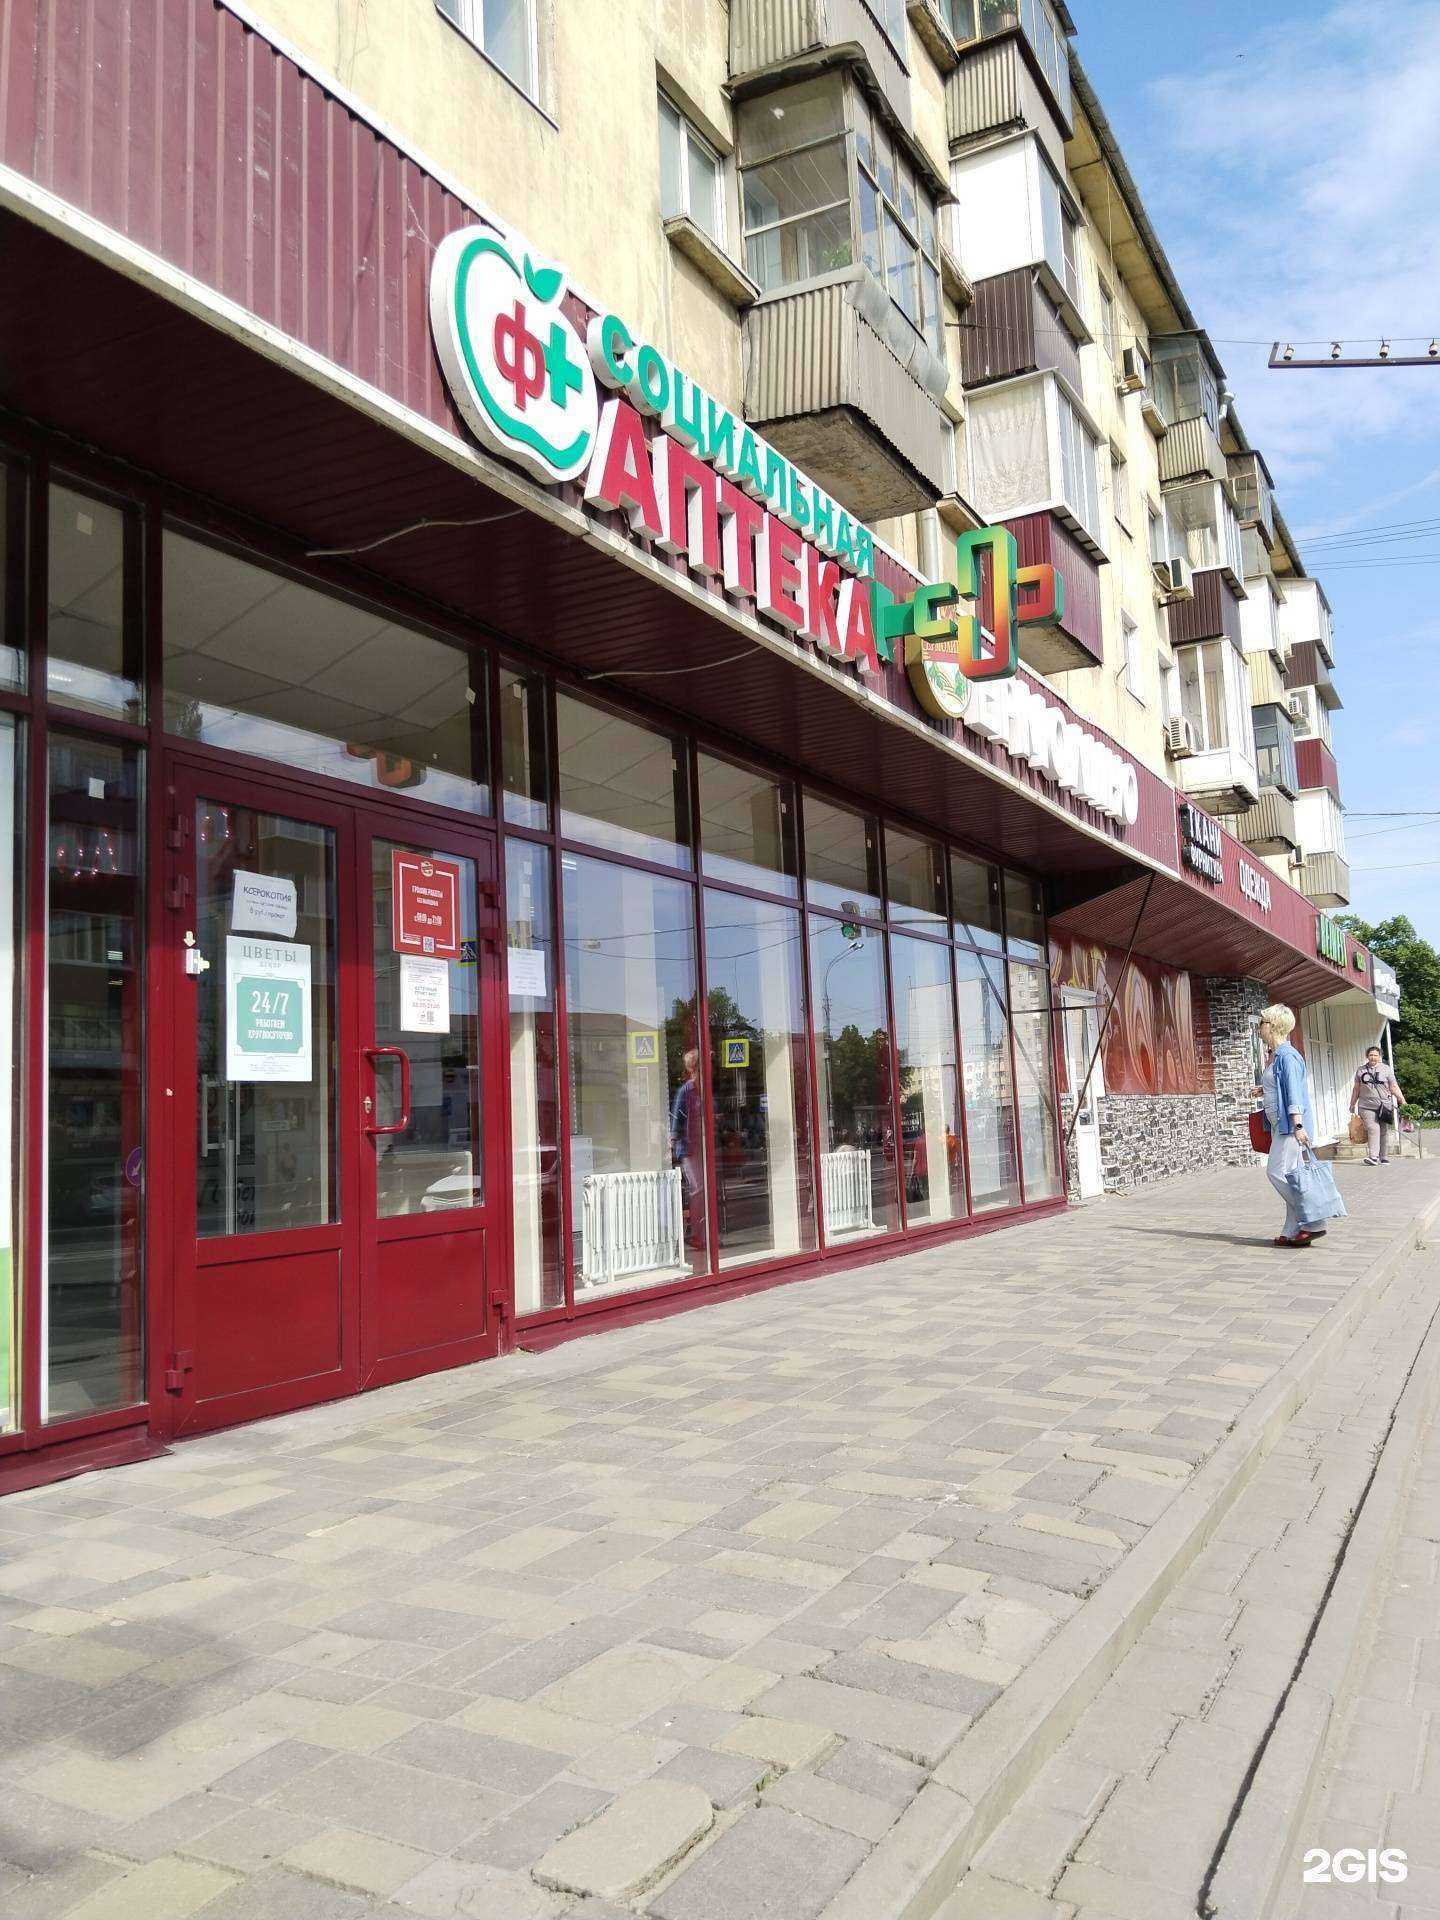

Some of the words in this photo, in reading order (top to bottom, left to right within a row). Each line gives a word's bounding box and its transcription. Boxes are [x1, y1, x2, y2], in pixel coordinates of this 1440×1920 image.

[588, 314, 875, 578] СОЦИАЛЬНАЯ
[586, 399, 881, 677] АПТЕКА
[1187, 804, 1222, 858] ТКАНИ
[243, 886, 292, 903] КСЕРОКОПИЯ
[1239, 858, 1272, 914] ОДЕЖДА
[243, 945, 297, 963] ЦВЕТЫ
[251, 990, 289, 1015] 24/7
